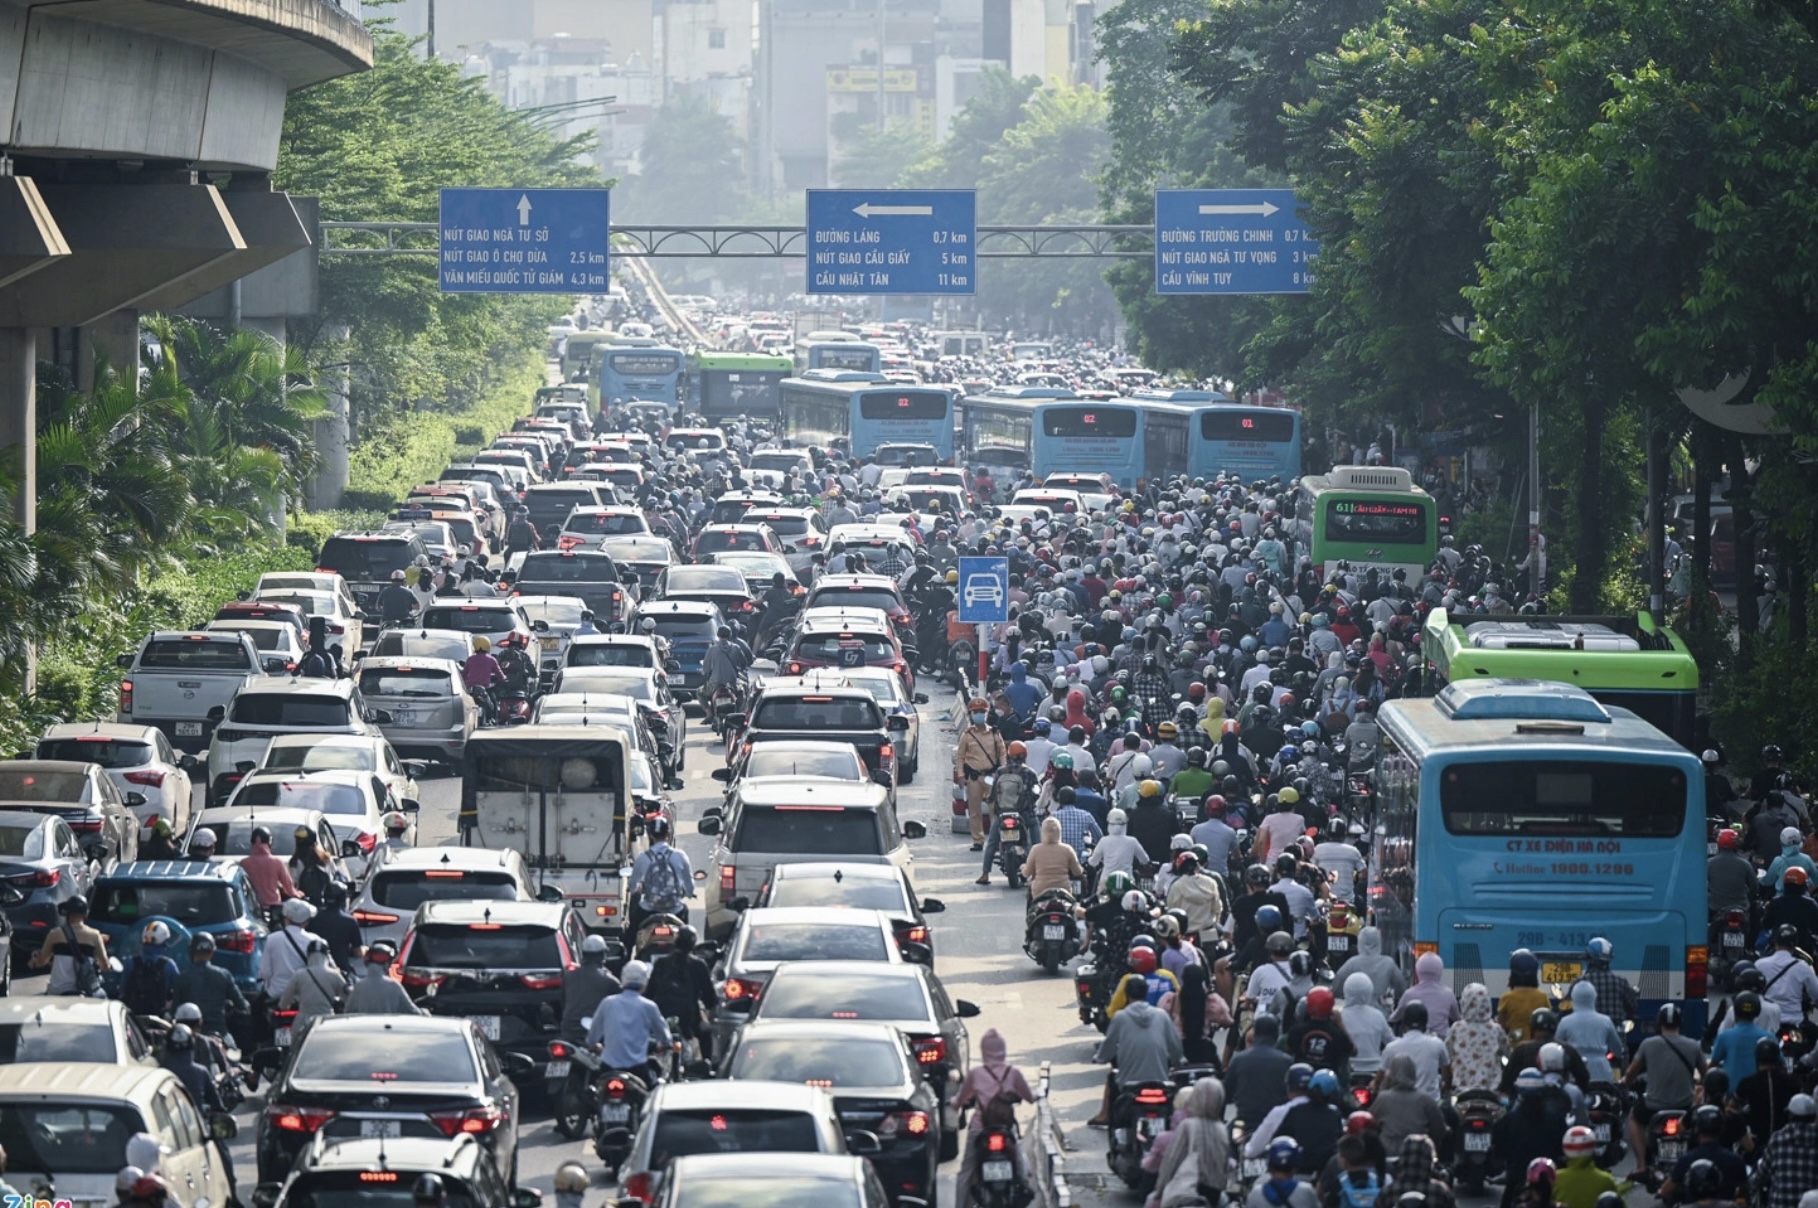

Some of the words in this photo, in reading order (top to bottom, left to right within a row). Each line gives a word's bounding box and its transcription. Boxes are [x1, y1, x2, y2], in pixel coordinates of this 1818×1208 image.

[444, 225, 463, 241] NÚT
[466, 229, 490, 241] GIAO
[493, 227, 513, 241] NGÃ
[518, 229, 531, 241] TƯ
[535, 226, 549, 241] SỞ
[816, 228, 850, 243] ĐƯỜNG
[854, 228, 880, 243] LÁNG
[952, 232, 967, 243] km
[1162, 227, 1196, 242] ĐƯỜNG
[1200, 226, 1240, 242] TRƯỜNG
[1243, 230, 1273, 242] CHINH
[444, 247, 463, 262] NÚT
[466, 250, 489, 262] GIAO
[493, 248, 500, 262] Ô
[504, 251, 523, 265] CHỢ
[589, 251, 604, 263] km
[816, 249, 835, 264] NÚT
[839, 252, 861, 264] GIAO
[865, 249, 884, 264] CẦU
[888, 248, 910, 264] GIẤY
[942, 253, 948, 264] 5
[952, 252, 967, 264] km
[1162, 248, 1181, 264] NÚT
[1185, 252, 1207, 264] GIAO
[1210, 249, 1230, 264] NGÃ
[1233, 252, 1245, 263] TƯ
[1250, 252, 1276, 266] VỌNG
[1293, 252, 1299, 263] 3
[444, 269, 463, 283] VĂN
[466, 268, 490, 283] MIẾU
[493, 268, 519, 284] QUỐC
[523, 268, 535, 284] TỬ
[539, 269, 564, 284] GIÁM
[589, 273, 604, 284] km
[816, 270, 835, 285] CẦU
[839, 271, 865, 288] NHẬT
[870, 271, 889, 285] TÂN
[938, 274, 948, 285] 11
[952, 274, 967, 285] km
[1162, 270, 1181, 285] CẦU
[1186, 271, 1209, 285] VĨNH
[1214, 273, 1232, 284] TUY
[1293, 273, 1299, 284] 8
[1084, 414, 1095, 423] 02
[1242, 418, 1253, 428] 01
[1336, 503, 1349, 512] 61
[845, 651, 859, 665] G7
[1506, 840, 1522, 852] CT
[1526, 840, 1541, 852] XE
[1506, 863, 1545, 874] Hotline
[1518, 932, 1544, 945] 29B
[1309, 1038, 1326, 1049] 12
